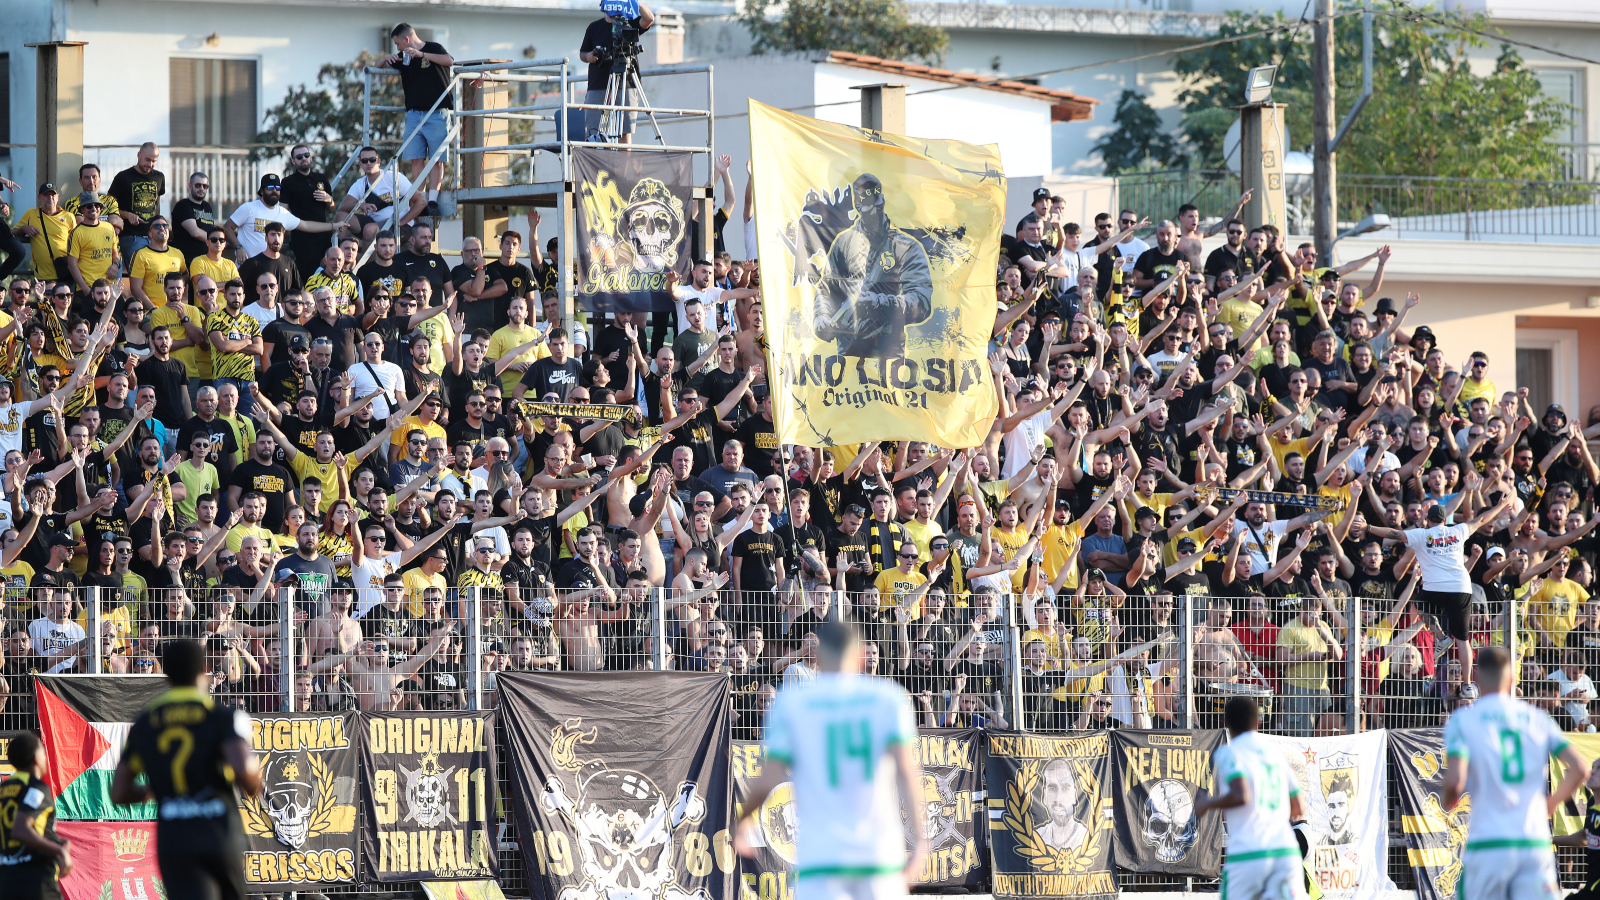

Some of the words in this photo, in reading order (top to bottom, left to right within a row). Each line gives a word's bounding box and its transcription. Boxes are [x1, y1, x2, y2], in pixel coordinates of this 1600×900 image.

[583, 263, 669, 295] Gialloner
[552, 370, 566, 378] JUST
[822, 387, 898, 410] Original
[905, 390, 929, 410] 21
[249, 716, 349, 751] RIGINAL
[369, 718, 488, 754] ORIGINAL
[1149, 735, 1175, 745] HARDCORE
[157, 726, 195, 797] 7
[826, 719, 874, 788] 14
[1499, 729, 1524, 783] 8
[374, 769, 398, 824] 9
[454, 767, 488, 822] 11
[245, 849, 354, 884] ERISSOS
[377, 830, 489, 873] TRIKALA
[435, 867, 454, 878] Club
[456, 869, 480, 878] since
